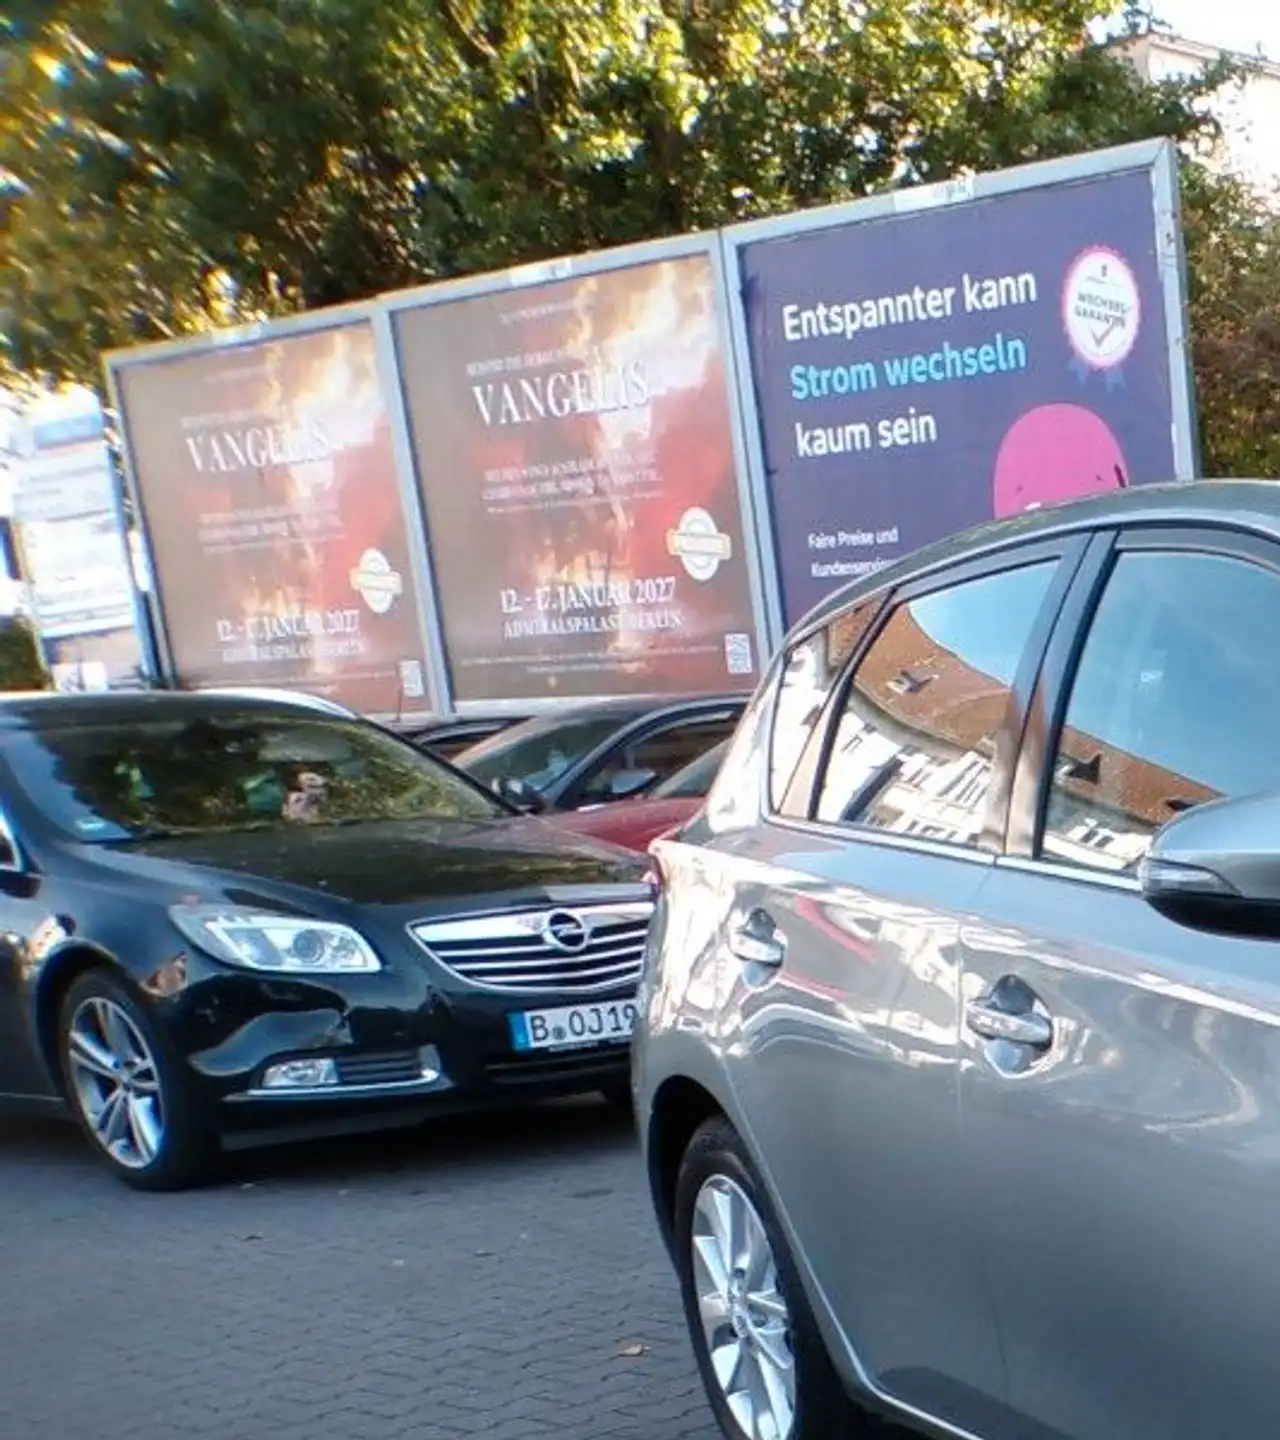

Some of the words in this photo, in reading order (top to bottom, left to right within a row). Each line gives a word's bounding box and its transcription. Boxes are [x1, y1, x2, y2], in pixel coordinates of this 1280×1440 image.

[783, 286, 956, 341] Entspannter
[962, 273, 1038, 313] kann
[790, 364, 877, 400] Strom
[884, 332, 1027, 388] wechseln
[185, 420, 330, 473] VANGES
[795, 422, 872, 458] kaum
[878, 406, 938, 449] sein
[808, 532, 836, 549] Faire
[837, 528, 874, 547] Preise
[875, 526, 899, 544] und
[634, 575, 676, 605] 2027
[530, 1015, 549, 1041] B
